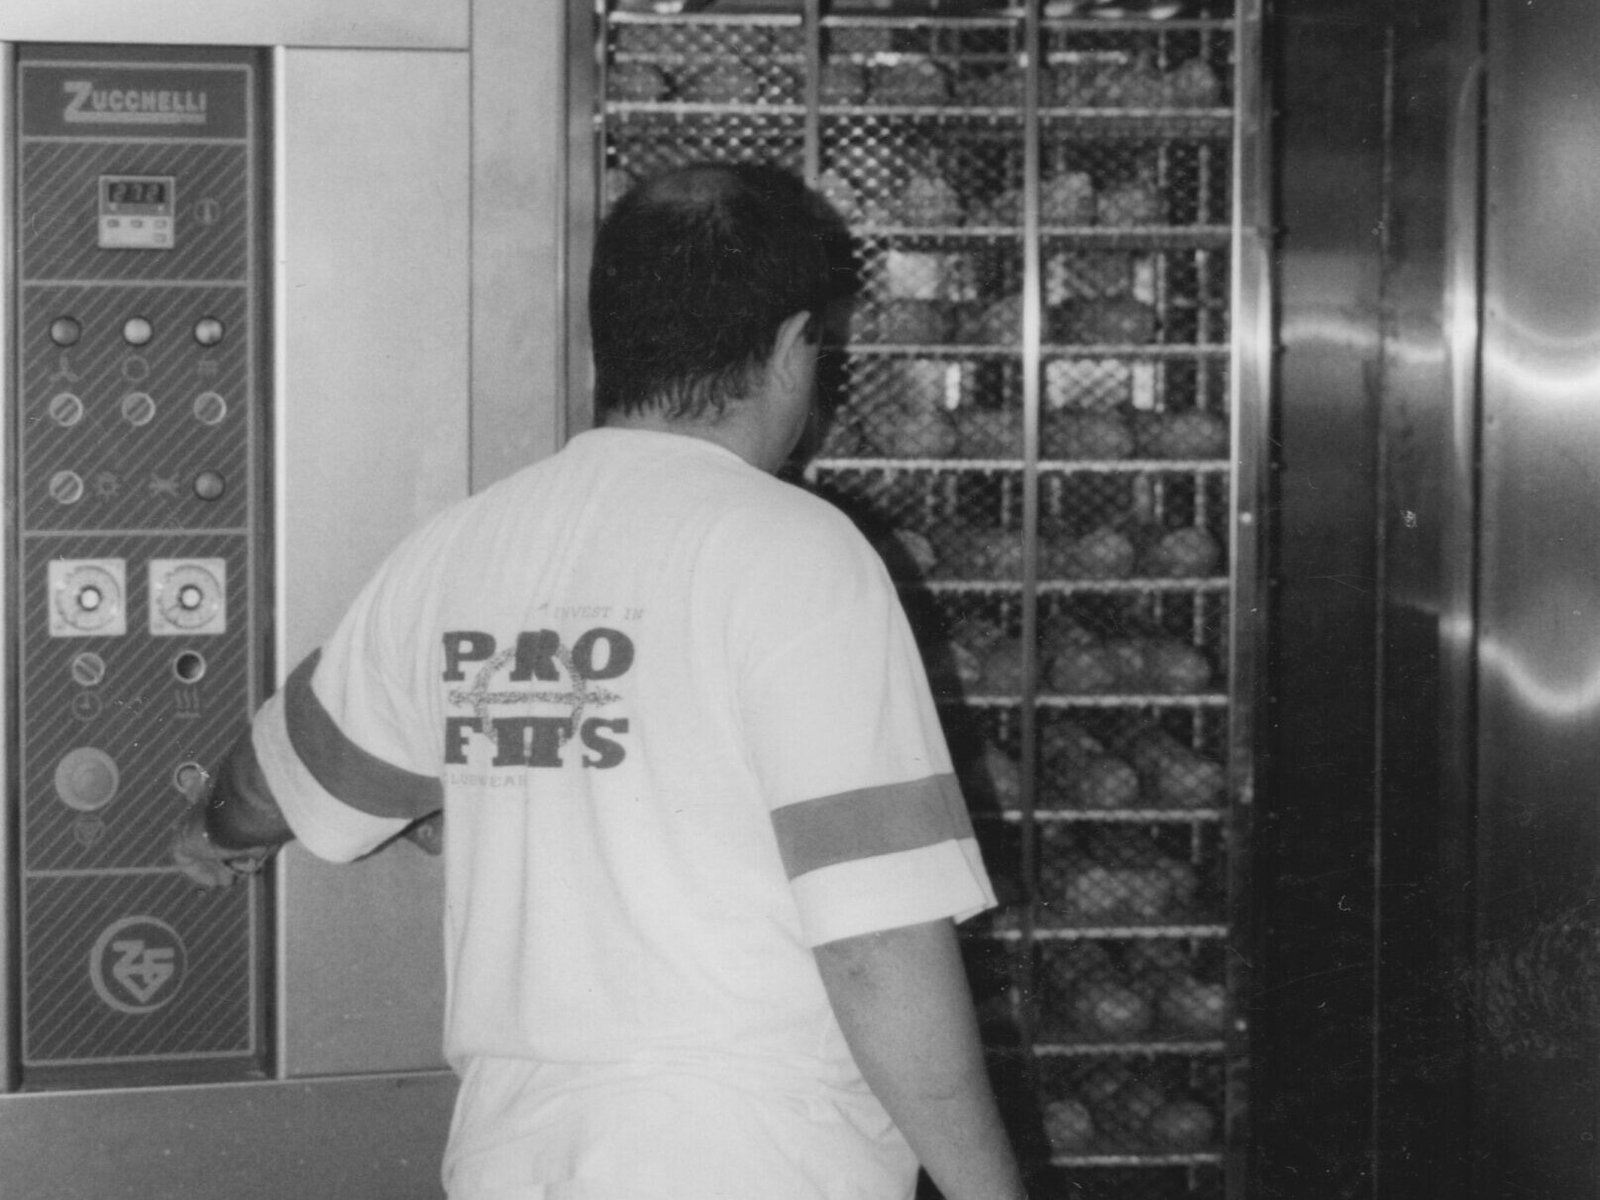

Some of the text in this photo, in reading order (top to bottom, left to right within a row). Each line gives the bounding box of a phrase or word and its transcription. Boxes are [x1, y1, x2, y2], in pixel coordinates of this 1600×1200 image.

[64, 81, 207, 124] ZUCCHELLI
[552, 605, 646, 621] INVEST IN
[442, 627, 635, 682] PRO
[445, 716, 629, 770] FITS
